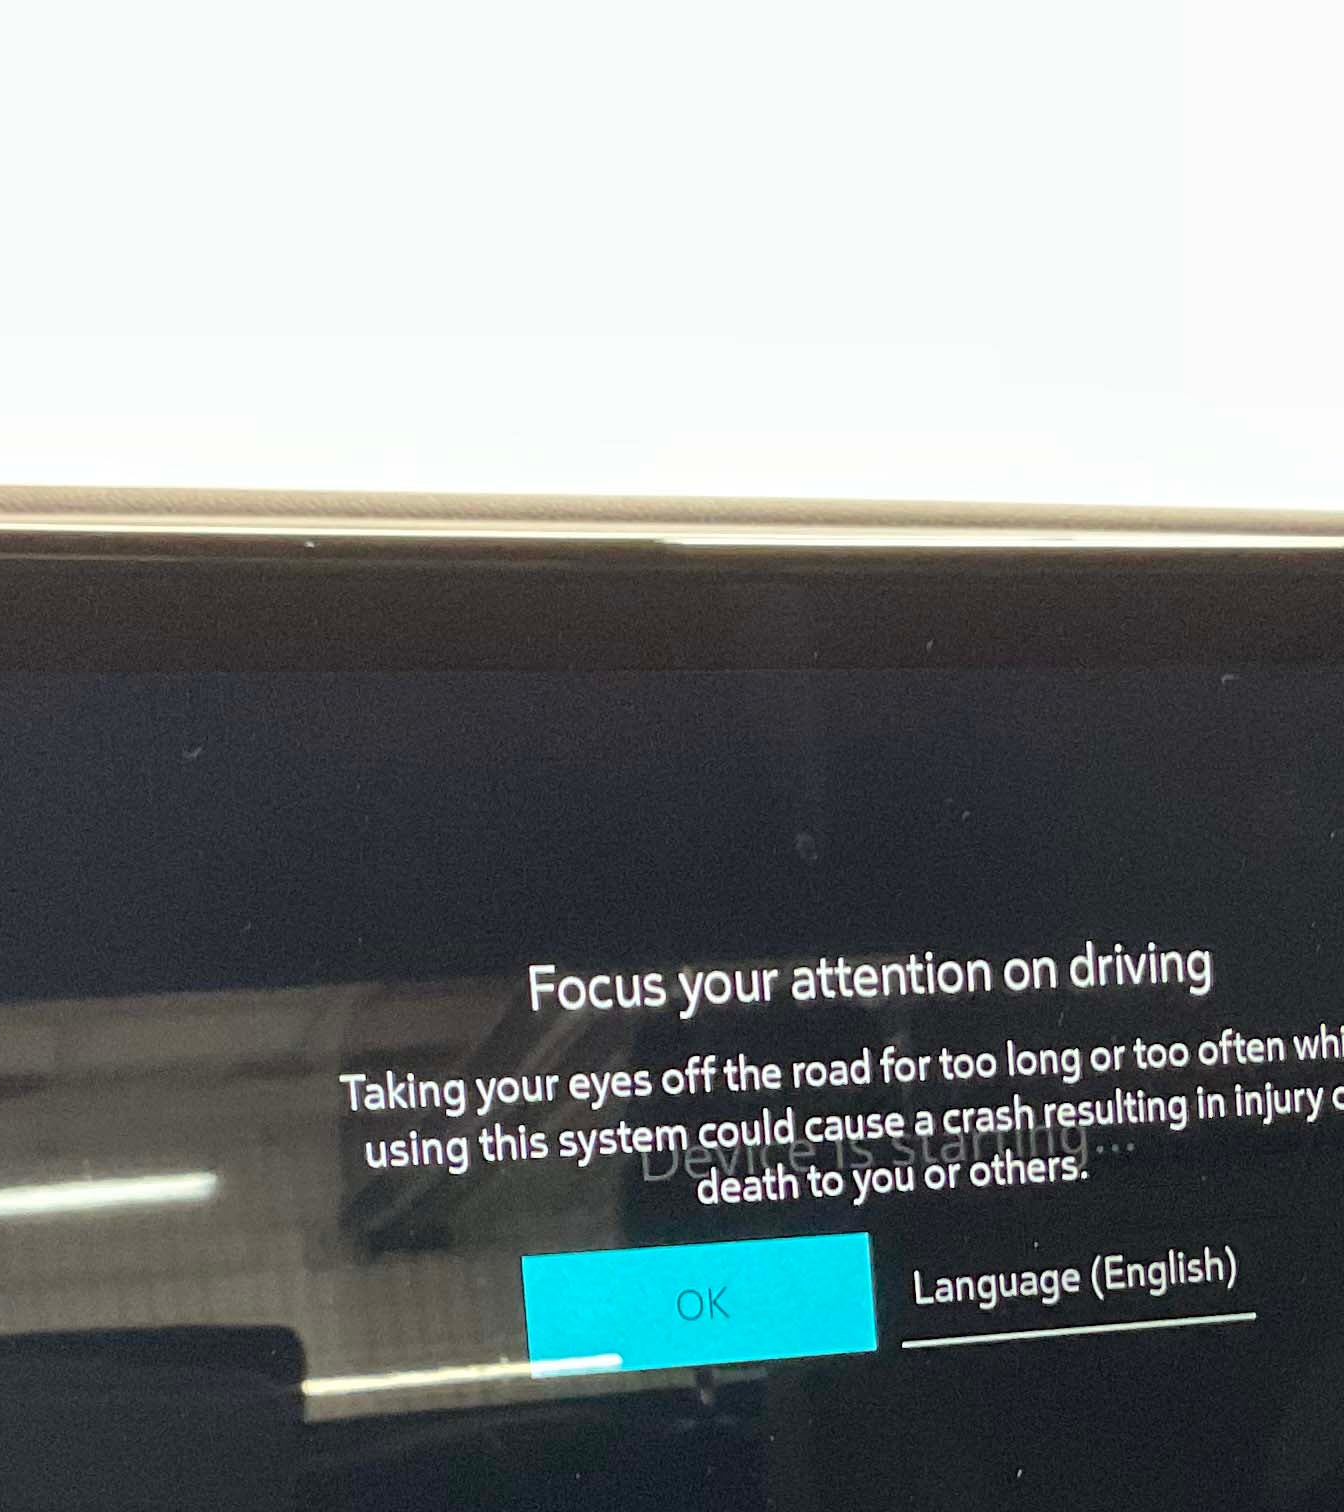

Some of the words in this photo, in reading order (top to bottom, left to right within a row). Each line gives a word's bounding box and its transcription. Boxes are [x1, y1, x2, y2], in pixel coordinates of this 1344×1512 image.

[528, 962, 667, 1012] Focus
[677, 966, 779, 1020] your
[791, 952, 992, 1001] attention
[1003, 954, 1057, 993] on
[1068, 940, 1215, 997] driving
[339, 1069, 467, 1117] Taking
[474, 1074, 560, 1116] your
[568, 1069, 654, 1111] eyes
[661, 1055, 720, 1096] off
[723, 1053, 782, 1092] the
[791, 1047, 871, 1089] road
[879, 1046, 932, 1086] for
[938, 1046, 998, 1082] too
[1006, 1040, 1082, 1086] long
[1090, 1042, 1126, 1074] or
[1132, 1037, 1190, 1070] too
[1198, 1028, 1286, 1066] often
[364, 1129, 471, 1176] using
[479, 1122, 550, 1164] this
[558, 1120, 689, 1168] system
[697, 1106, 796, 1151] could
[804, 1109, 906, 1144] cause
[913, 1107, 935, 1138] a
[942, 1094, 1035, 1134] crash
[1043, 1088, 1188, 1132] resulting
[1196, 1085, 1227, 1120] in
[1234, 1081, 1325, 1127] injury
[640, 1133, 818, 1183] Device
[697, 1161, 800, 1207] death
[804, 1164, 844, 1199] to
[853, 1165, 915, 1207] you
[923, 1158, 961, 1191] or
[968, 1148, 1090, 1188] others.
[676, 1286, 731, 1323] OK
[912, 1266, 1082, 1311] Language
[1090, 1245, 1239, 1302] (English)
